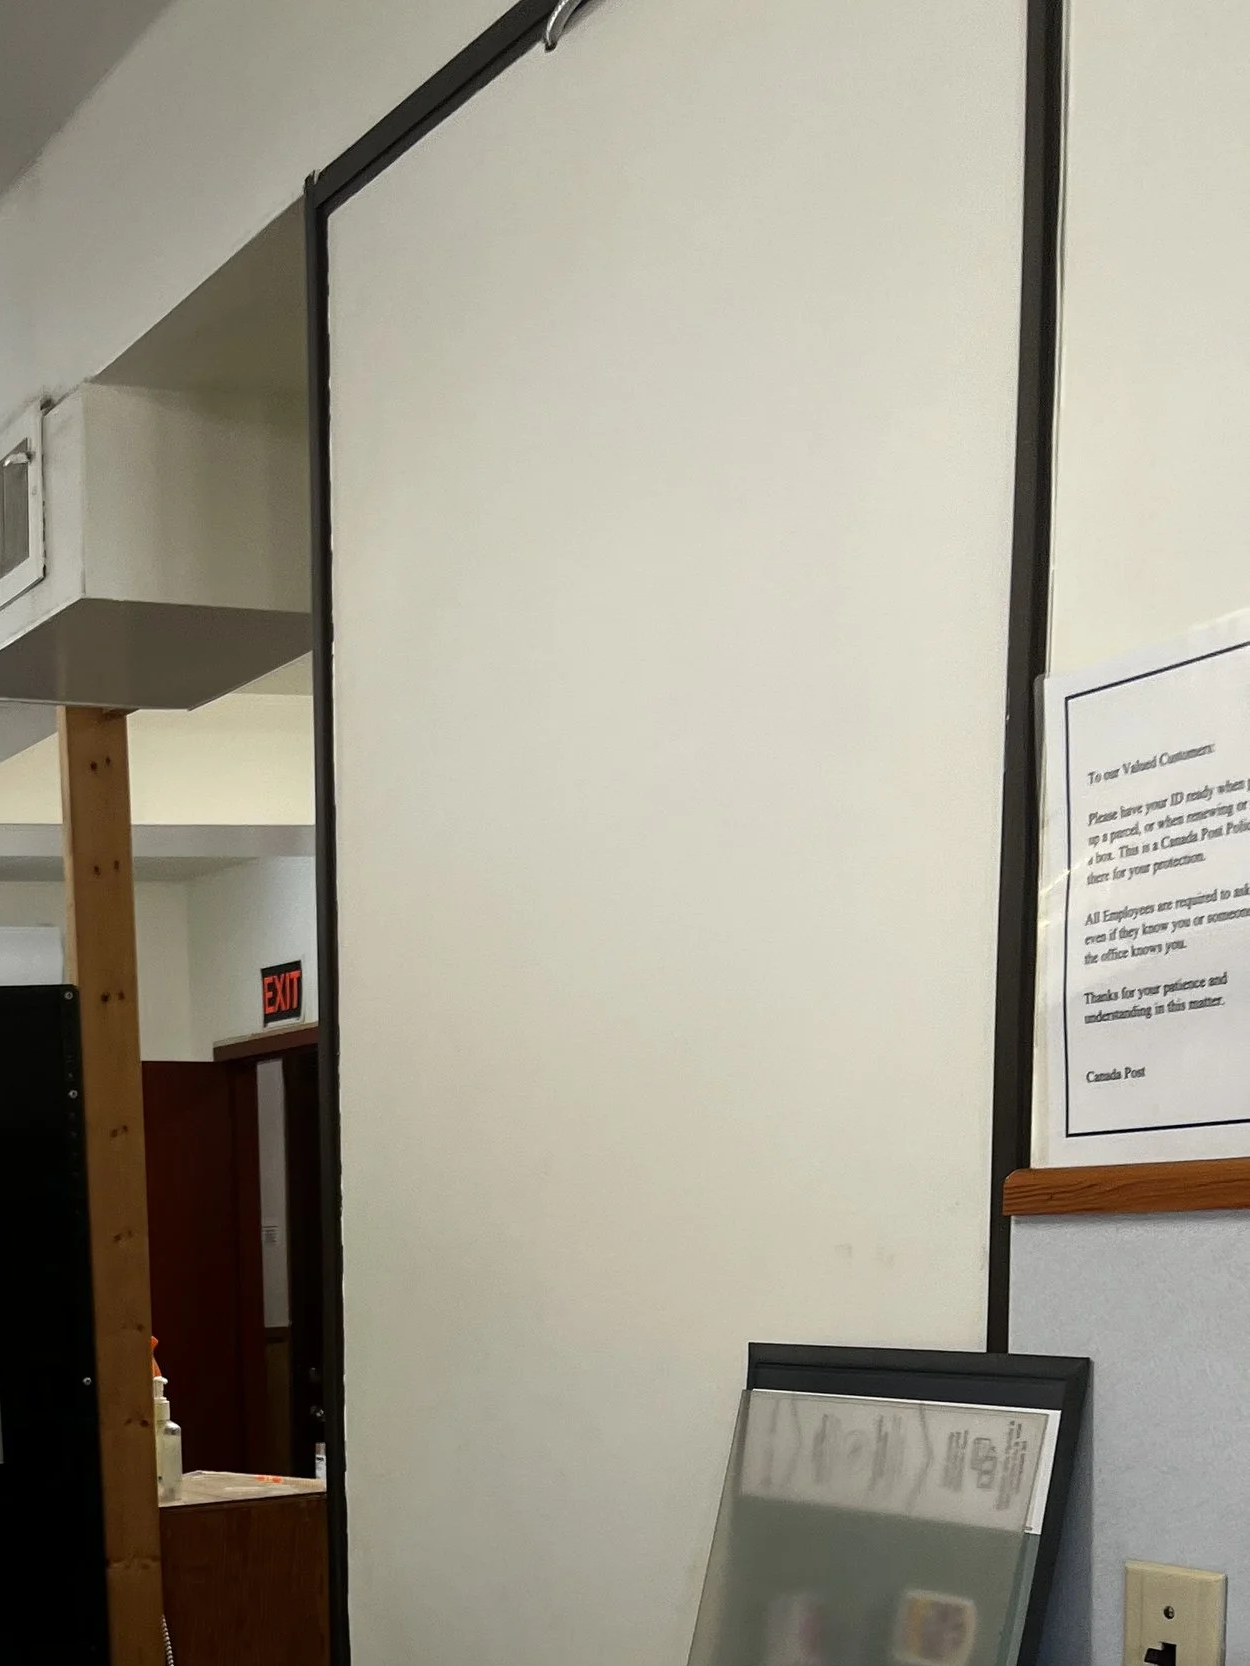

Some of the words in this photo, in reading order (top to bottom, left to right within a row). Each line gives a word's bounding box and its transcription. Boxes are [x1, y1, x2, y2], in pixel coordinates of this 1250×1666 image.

[1088, 771, 1101, 785] To
[1104, 769, 1120, 780] our
[1123, 757, 1156, 774] Valued
[1088, 812, 1117, 826] Please
[1120, 806, 1142, 818] have
[1146, 799, 1167, 815] your
[1170, 792, 1184, 806] ID
[1186, 786, 1213, 803] ready
[1217, 780, 1245, 793] when
[264, 970, 300, 1014] EXIT
[1084, 989, 1119, 1005] Thanks
[1121, 986, 1135, 999] for
[1138, 984, 1161, 999] your
[1163, 979, 1206, 996] patience
[1208, 972, 1228, 986] and
[1086, 1069, 1122, 1083] Canada
[1124, 1066, 1145, 1079] Post
